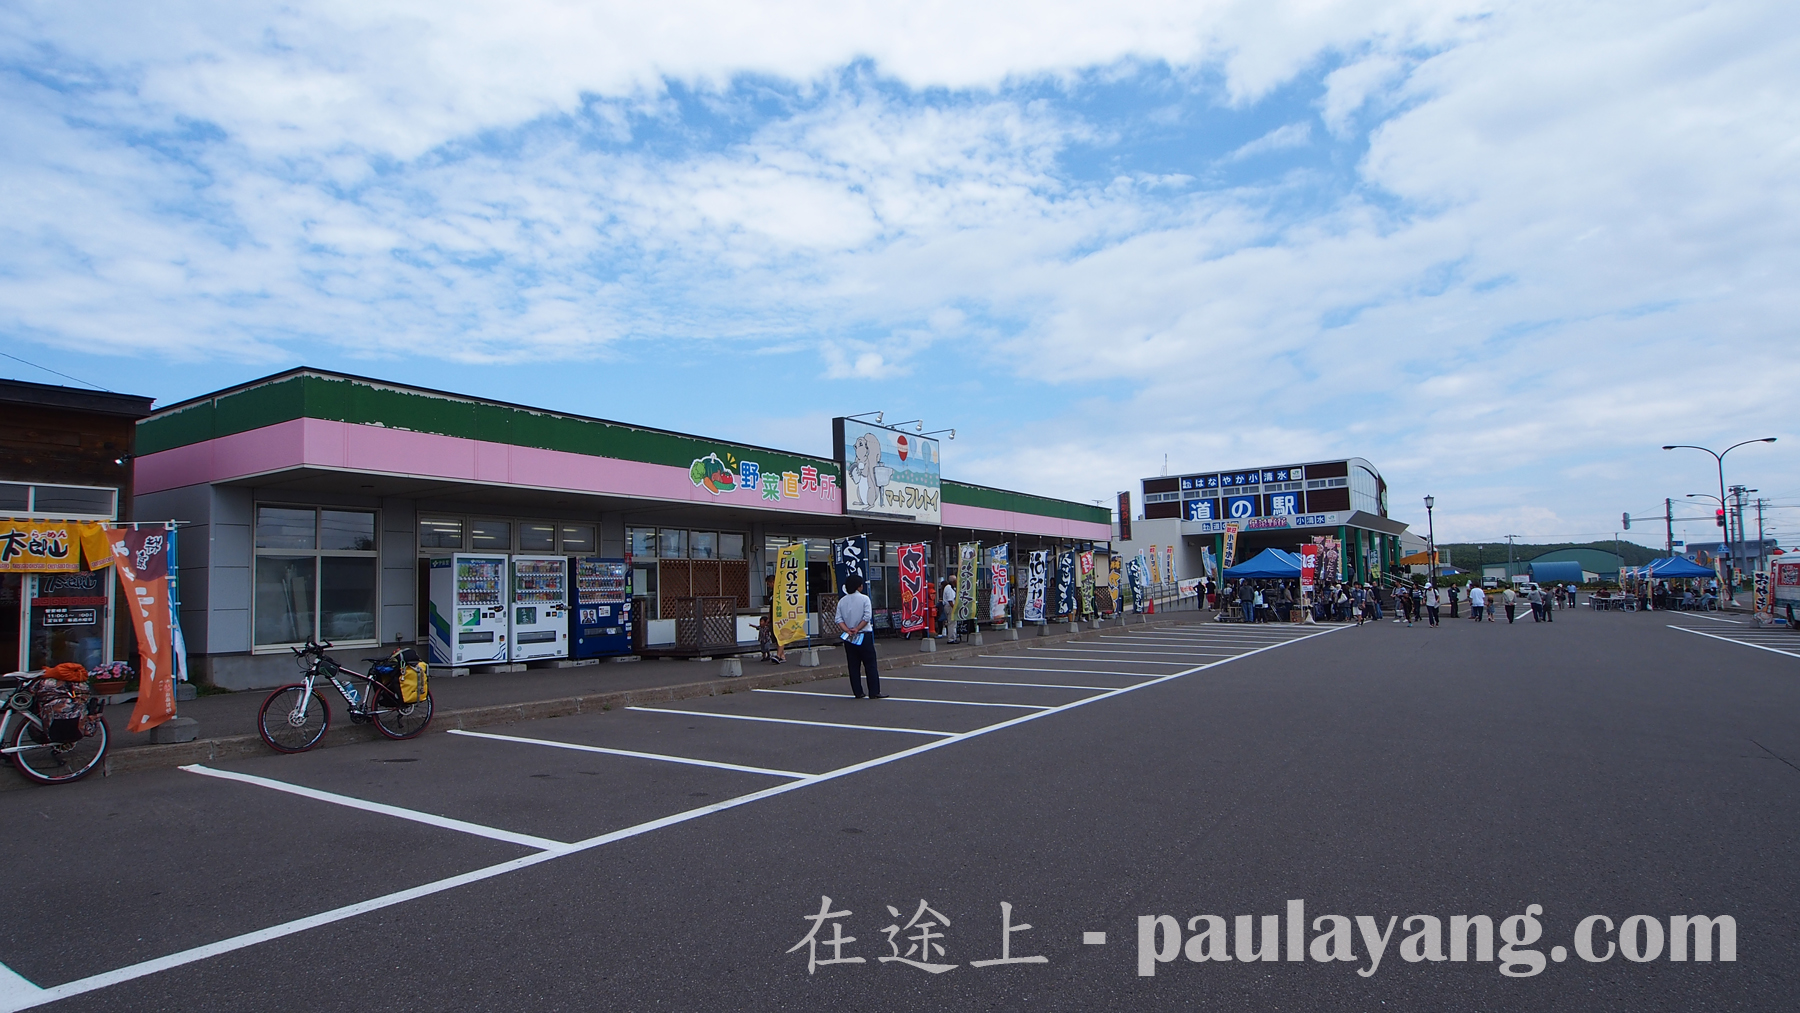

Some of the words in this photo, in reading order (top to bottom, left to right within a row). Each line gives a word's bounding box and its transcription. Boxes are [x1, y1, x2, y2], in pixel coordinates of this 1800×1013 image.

[740, 461, 837, 501] 野菜直売所
[1195, 471, 1287, 488] はなやか小清水
[1191, 495, 1296, 522] 道の駅
[31, 530, 68, 538] らーめん
[1302, 554, 1316, 568] ほ
